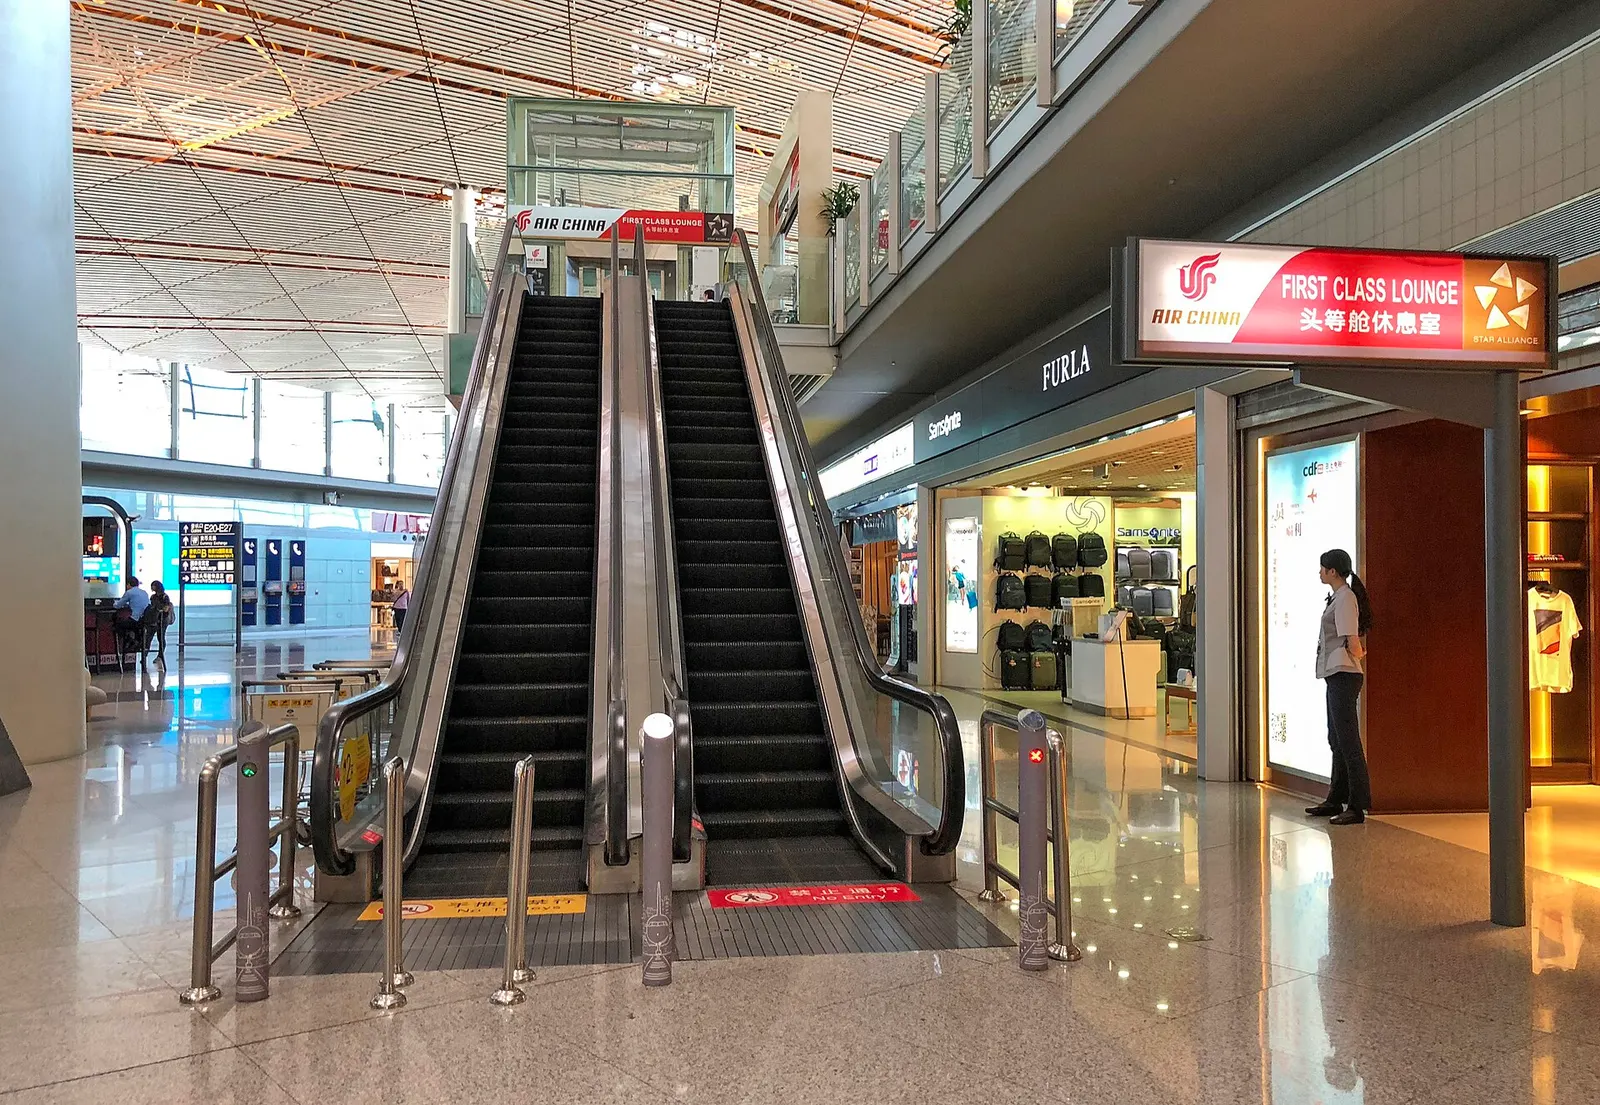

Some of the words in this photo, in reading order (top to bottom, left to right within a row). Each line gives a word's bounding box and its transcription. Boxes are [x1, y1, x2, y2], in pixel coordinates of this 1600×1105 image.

[534, 217, 558, 230] AIR
[562, 218, 606, 231] CHINA
[622, 216, 644, 225] FIRST
[645, 218, 670, 226] CLASS
[671, 219, 703, 227] LOUNGE
[1281, 273, 1328, 300] FIRST
[1333, 276, 1386, 303] CLASS
[1392, 278, 1458, 305] LOUNGE
[1152, 309, 1183, 324] AIR
[1187, 310, 1241, 325] CHINA
[1300, 307, 1441, 336] 头等舱休息室
[1473, 335, 1495, 343] STAR
[1497, 336, 1539, 345] ALLIANCE
[1042, 344, 1091, 392] FURLA
[928, 410, 962, 441] Samsonite
[204, 523, 233, 533] E20-E27
[1117, 527, 1181, 538] Samsonite
